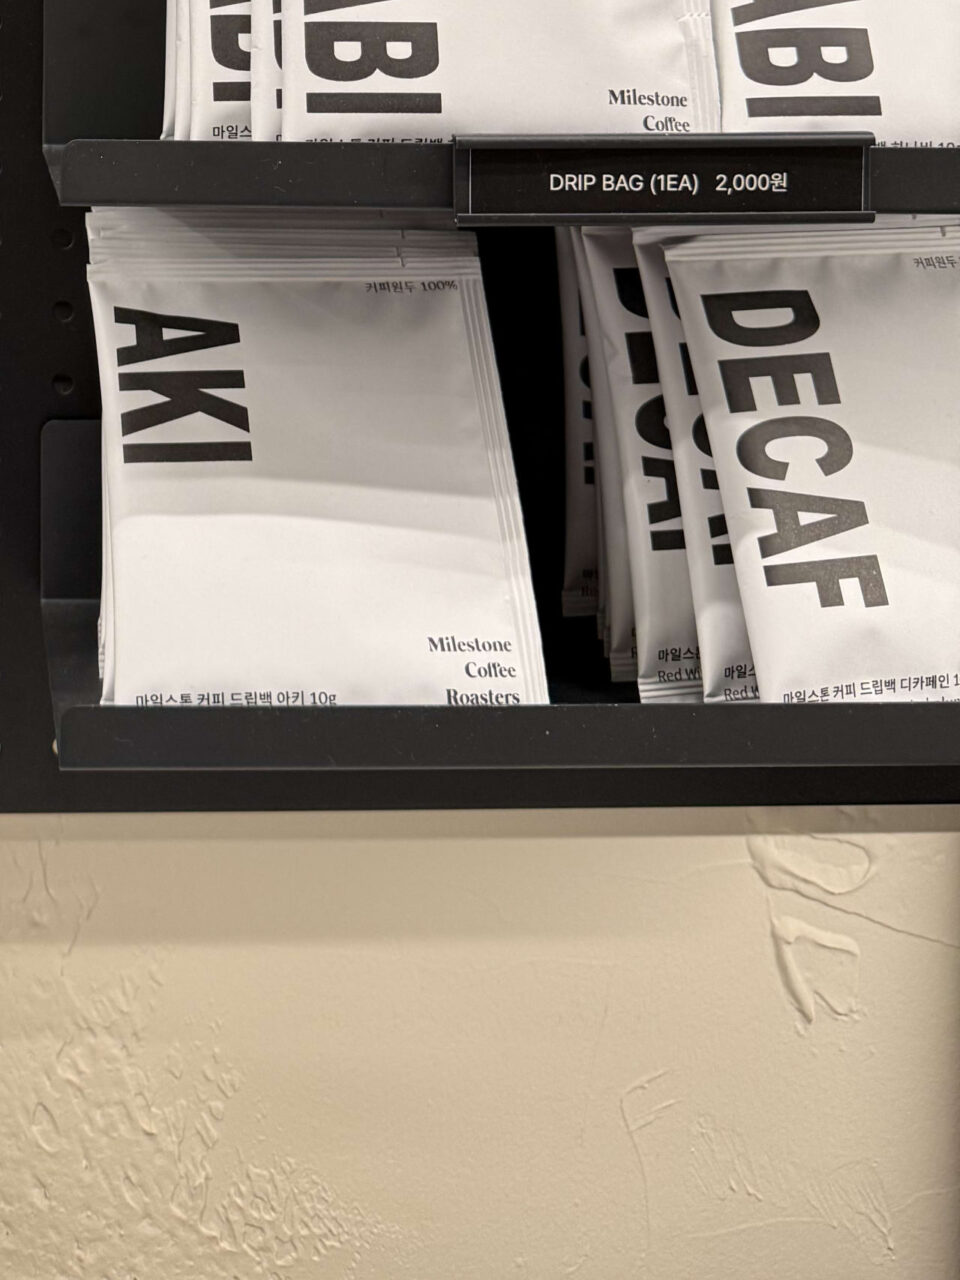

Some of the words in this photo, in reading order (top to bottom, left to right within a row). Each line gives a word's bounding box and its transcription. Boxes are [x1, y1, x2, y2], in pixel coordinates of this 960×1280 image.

[608, 88, 688, 107] Milestone
[642, 114, 691, 132] Coffee
[549, 173, 596, 192] DRIP
[602, 173, 644, 192] BAG
[650, 173, 699, 195] (1EA)
[715, 172, 788, 195] 2,000원
[364, 280, 416, 294] 커피원두
[420, 280, 458, 292] 100%
[114, 306, 253, 464] AKI
[700, 289, 890, 608] DECAF
[427, 635, 512, 652] Milestone
[464, 661, 517, 678] Coffee
[657, 669, 682, 683] Red
[446, 688, 520, 706] Roasters
[724, 685, 748, 701] Red
[783, 687, 829, 703] 마일스톤
[833, 682, 856, 699] 커피
[860, 678, 896, 695] 드립백
[900, 673, 950, 692] 디카페인
[197, 691, 224, 706] 커피
[230, 691, 272, 706] 드립백
[277, 691, 304, 706] 아키
[310, 691, 338, 706] 10g
